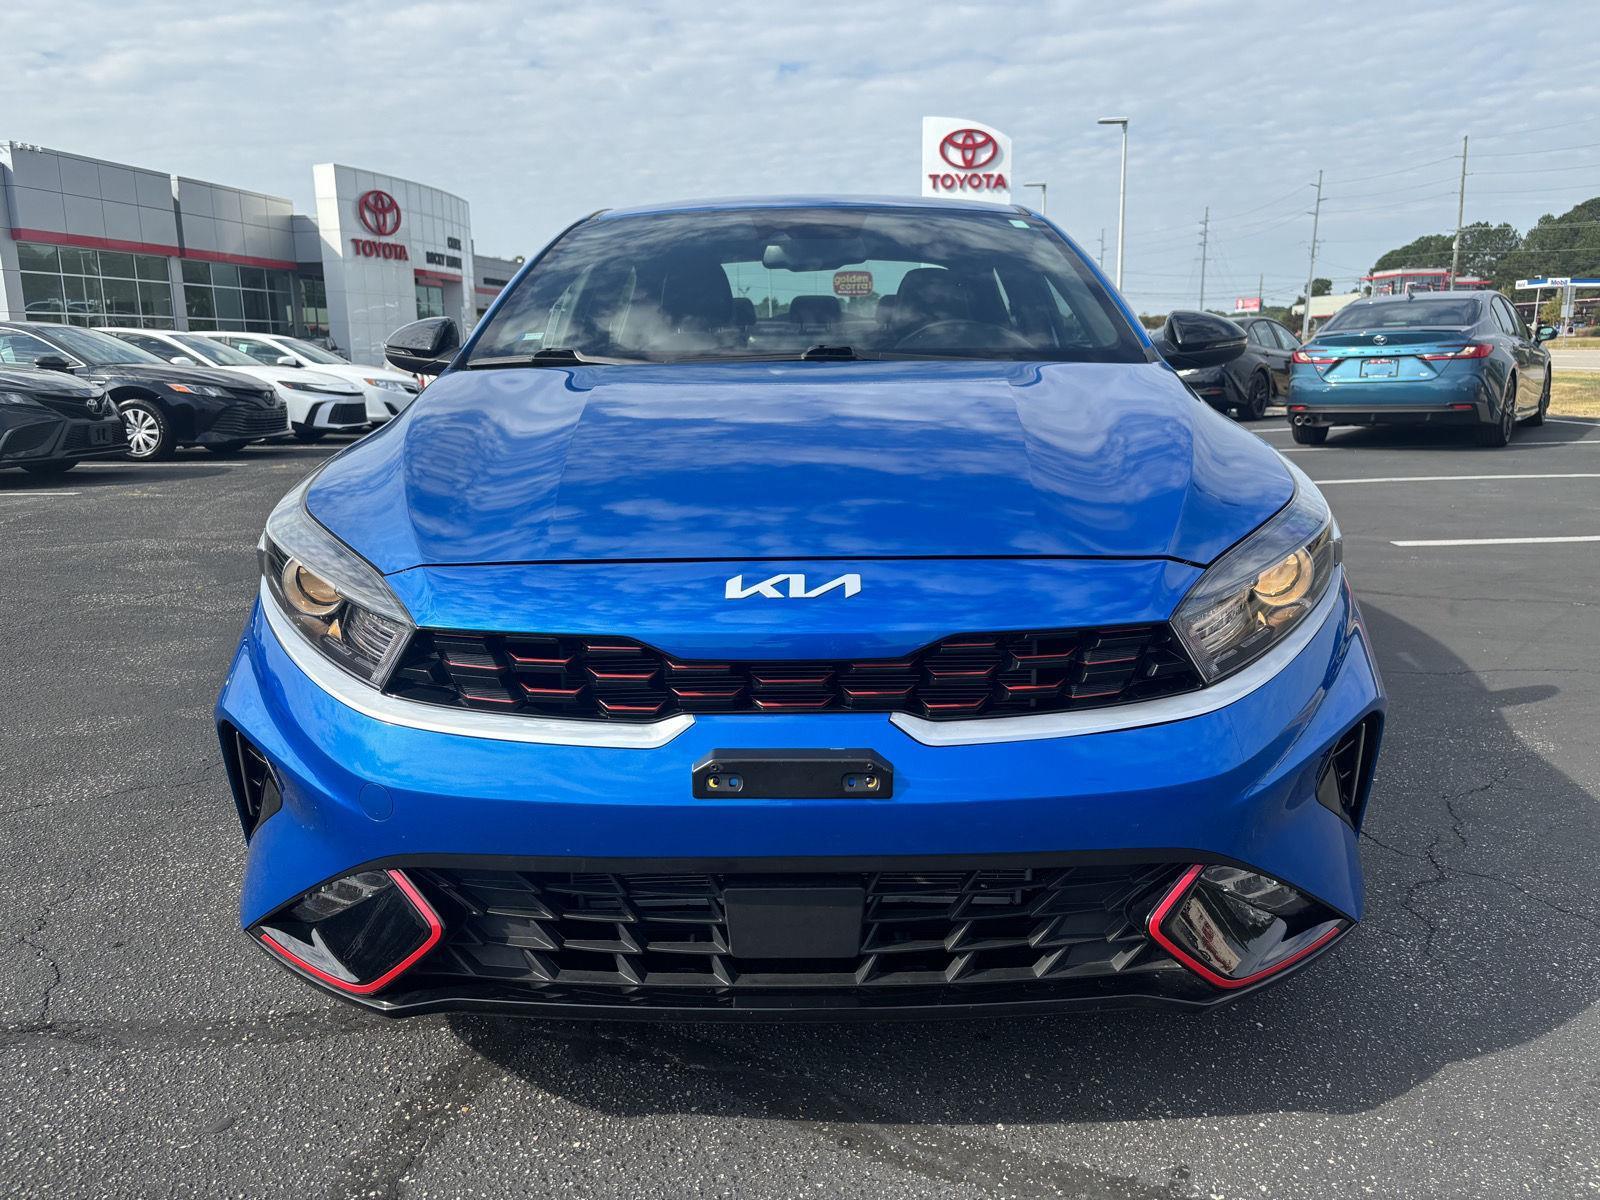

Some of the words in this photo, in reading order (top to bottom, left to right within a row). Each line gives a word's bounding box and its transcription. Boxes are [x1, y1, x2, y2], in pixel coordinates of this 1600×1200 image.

[928, 173, 1007, 190] TOYOTA
[351, 238, 409, 261] TOYOTA
[725, 573, 862, 599] KIA
